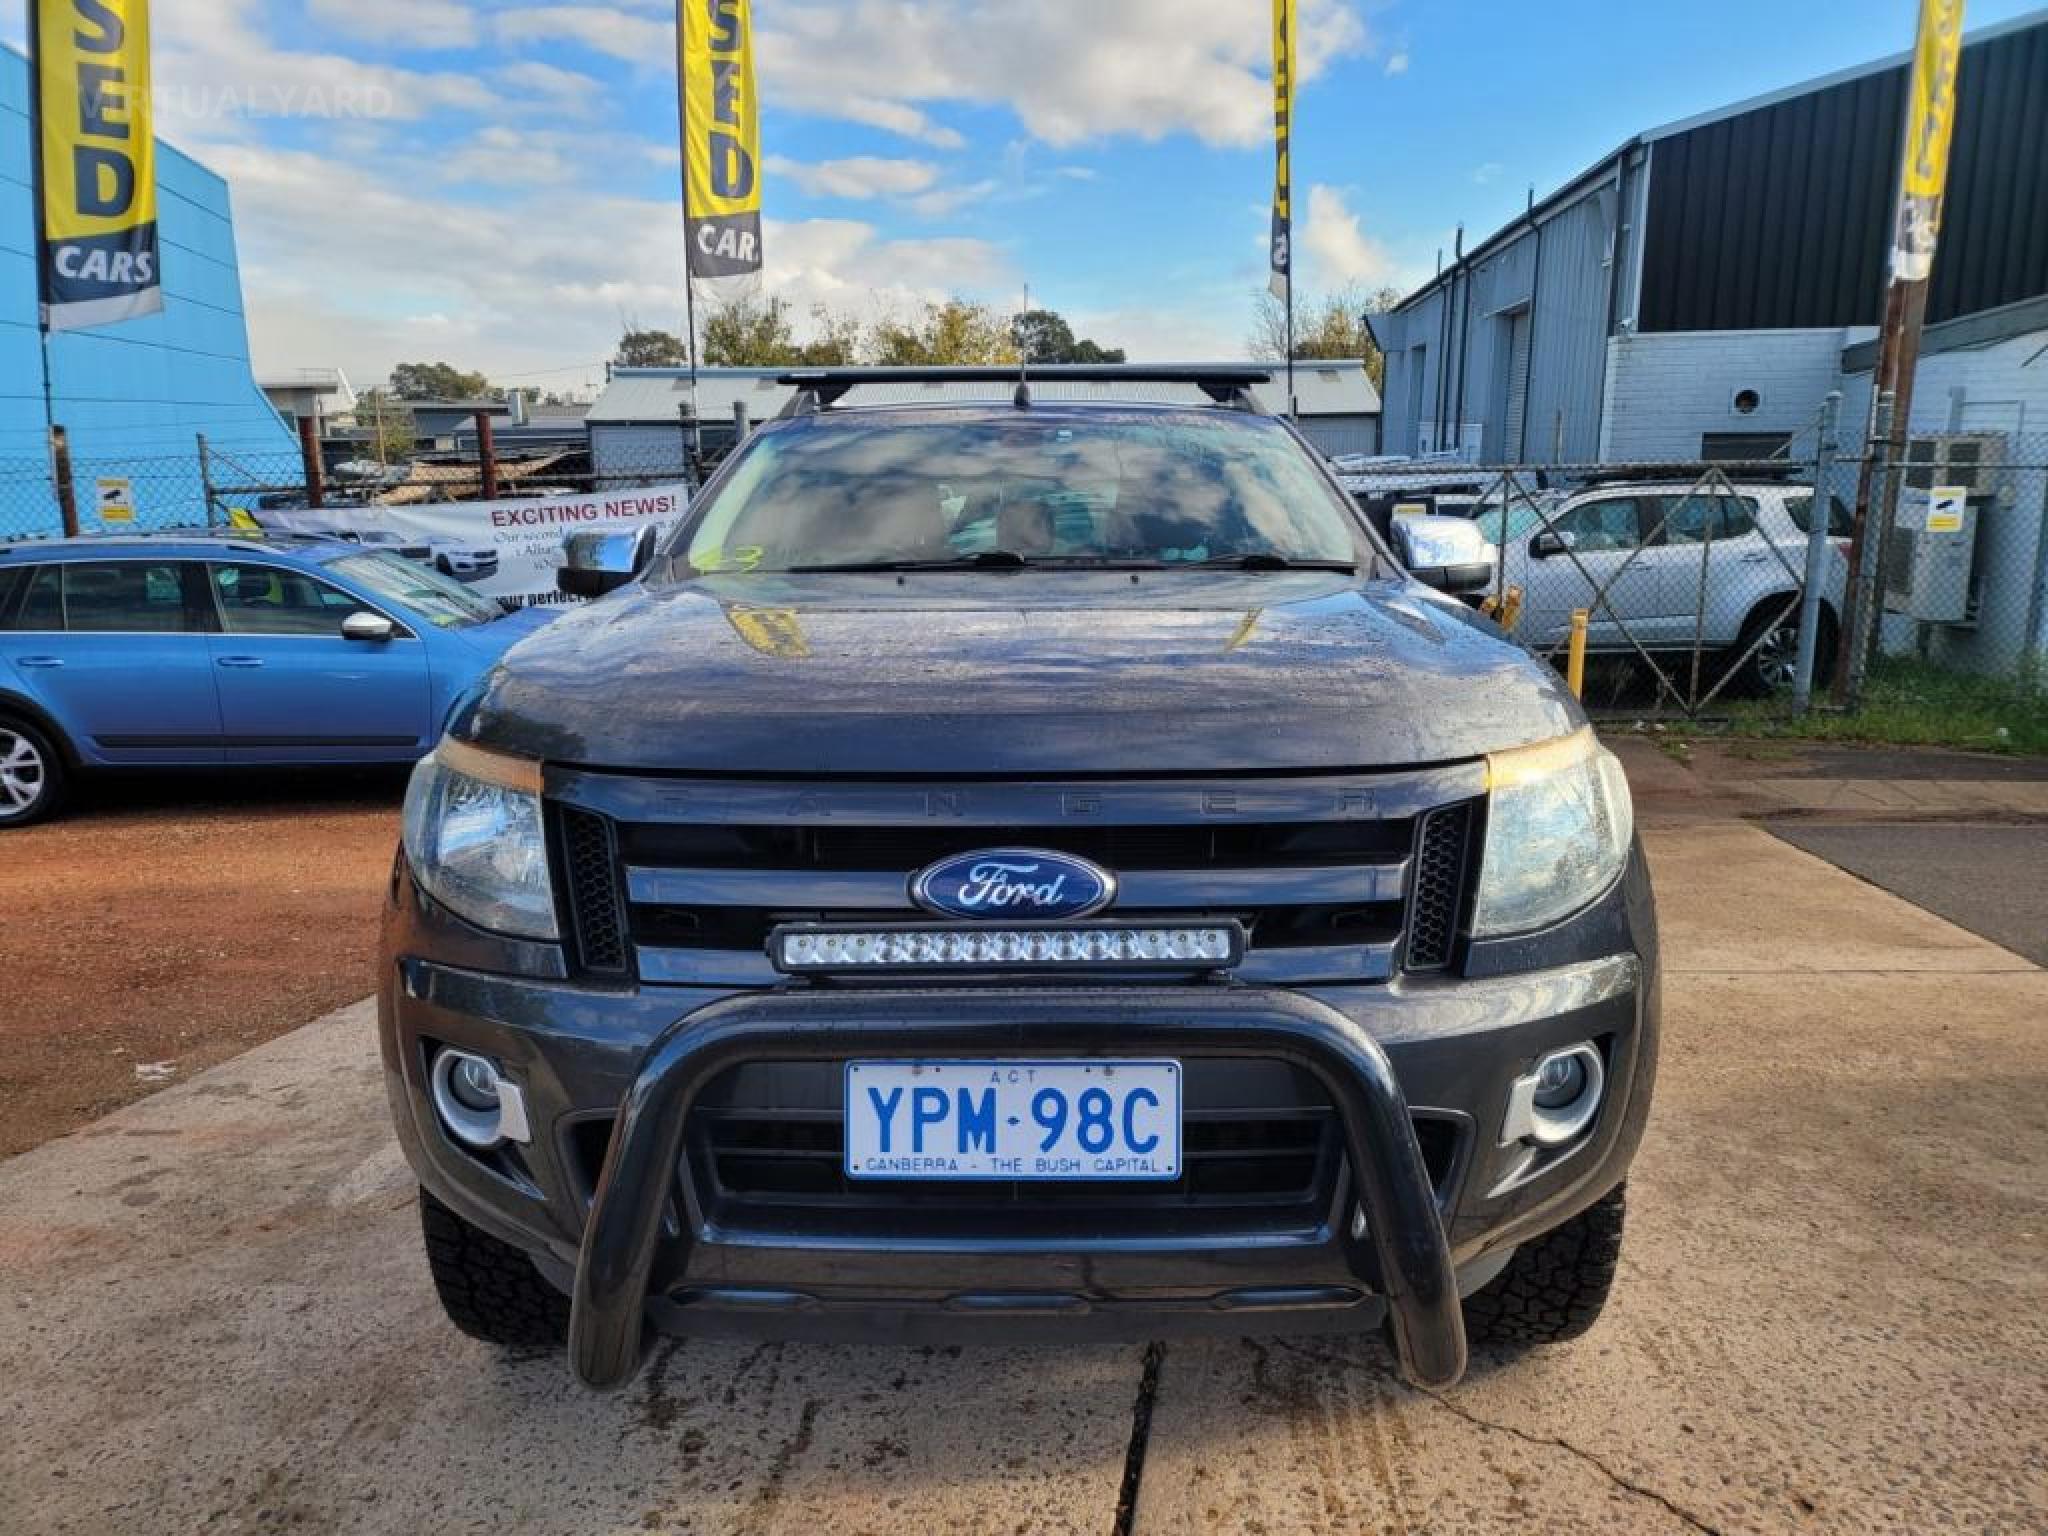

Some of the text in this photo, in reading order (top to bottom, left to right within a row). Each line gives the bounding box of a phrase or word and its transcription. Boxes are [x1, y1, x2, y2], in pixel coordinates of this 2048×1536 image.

[698, 223, 759, 262] CAR
[56, 246, 153, 283] CARS
[491, 495, 677, 526] EXCITING NEWS!
[958, 864, 1066, 905] Ford
[866, 1157, 958, 1171] CANBERRA
[992, 1157, 1023, 1171] THE
[1036, 1157, 1081, 1171] BUSH
[1094, 1157, 1161, 1172] CAPITAL
